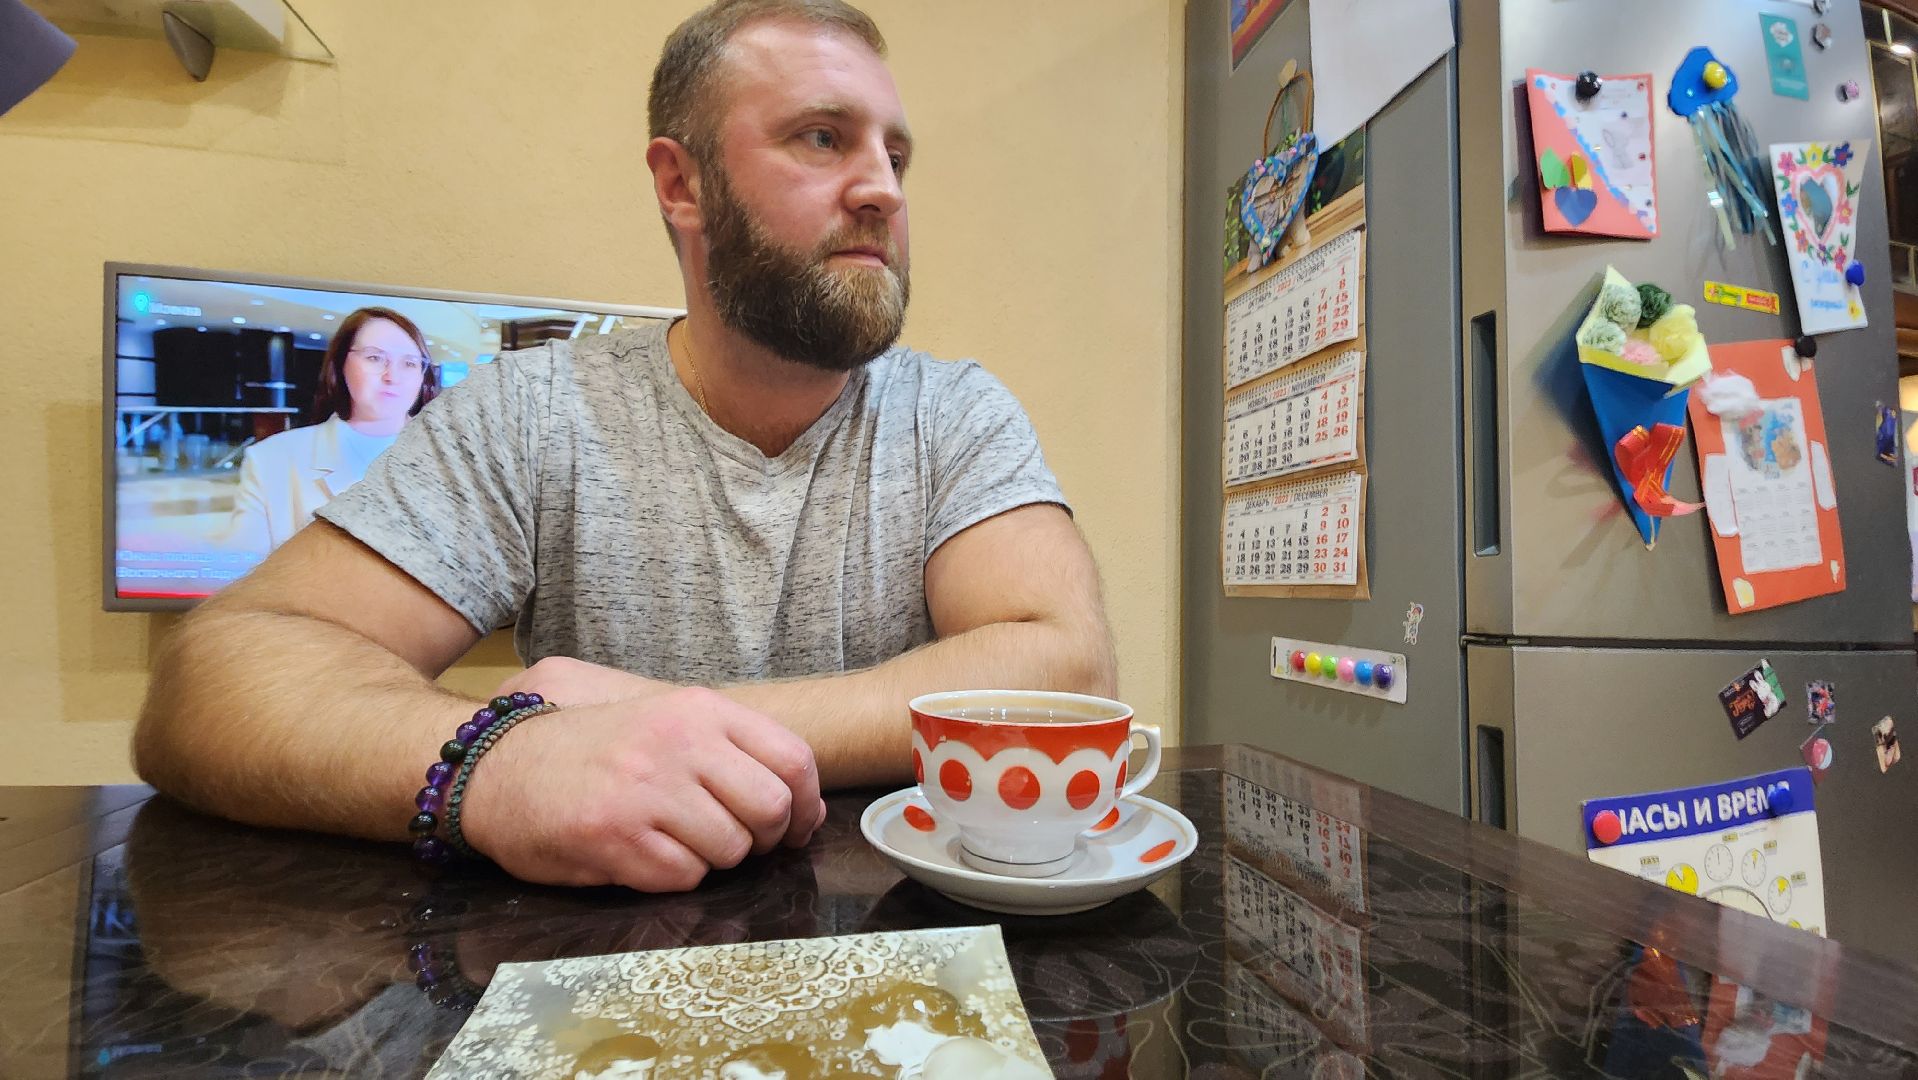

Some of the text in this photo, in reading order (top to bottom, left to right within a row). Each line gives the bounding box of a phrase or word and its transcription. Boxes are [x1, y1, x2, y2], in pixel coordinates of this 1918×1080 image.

[1341, 266, 1345, 275] 1
[1320, 288, 1327, 299] 7
[1254, 333, 1263, 346] 10
[1270, 327, 1277, 338] 11
[1300, 311, 1310, 322] 13
[1317, 302, 1327, 314] 14
[1336, 293, 1348, 304] 15
[1254, 345, 1262, 357] 17
[1269, 339, 1278, 350] 18
[1298, 323, 1310, 334] 20
[1316, 315, 1326, 326] 21
[1333, 305, 1349, 317] 22
[1298, 336, 1309, 350] 27
[1315, 328, 1326, 341] 28
[1272, 409, 1276, 418] 1
[1304, 397, 1309, 407] 3
[1321, 390, 1328, 399] 4
[1341, 385, 1346, 394] 5
[1243, 430, 1248, 439] 6
[1271, 421, 1275, 430] 8
[1286, 416, 1291, 425] 9
[1301, 410, 1310, 420] 10
[1319, 404, 1328, 414] 11
[1337, 398, 1349, 408] 12
[1240, 411, 1347, 452] 13 14 15 16 17 18 19
[1239, 453, 1249, 463] 20
[1254, 450, 1262, 459] 21
[1282, 441, 1292, 450] 23
[1298, 437, 1309, 447] 24
[1315, 431, 1328, 442] 25
[1333, 426, 1348, 438] 26
[1239, 465, 1248, 475] 27
[1266, 456, 1276, 467] 29
[1282, 454, 1292, 464] 30
[1245, 499, 1269, 510] ДЕКАБРЬ
[1274, 494, 1288, 504] 2023
[1304, 504, 1347, 519] 1 2 3
[1241, 518, 1349, 539] 4 5 6 7 8 9 10
[1239, 533, 1348, 551] 11 12 13 14 15 16 17
[1237, 547, 1348, 563] 18 19 20 21 22 23 24
[1235, 562, 1346, 575] 25 26 27 28 29 30 31
[1693, 797, 1713, 826] И
[1717, 781, 1790, 821] ВРЕМ
